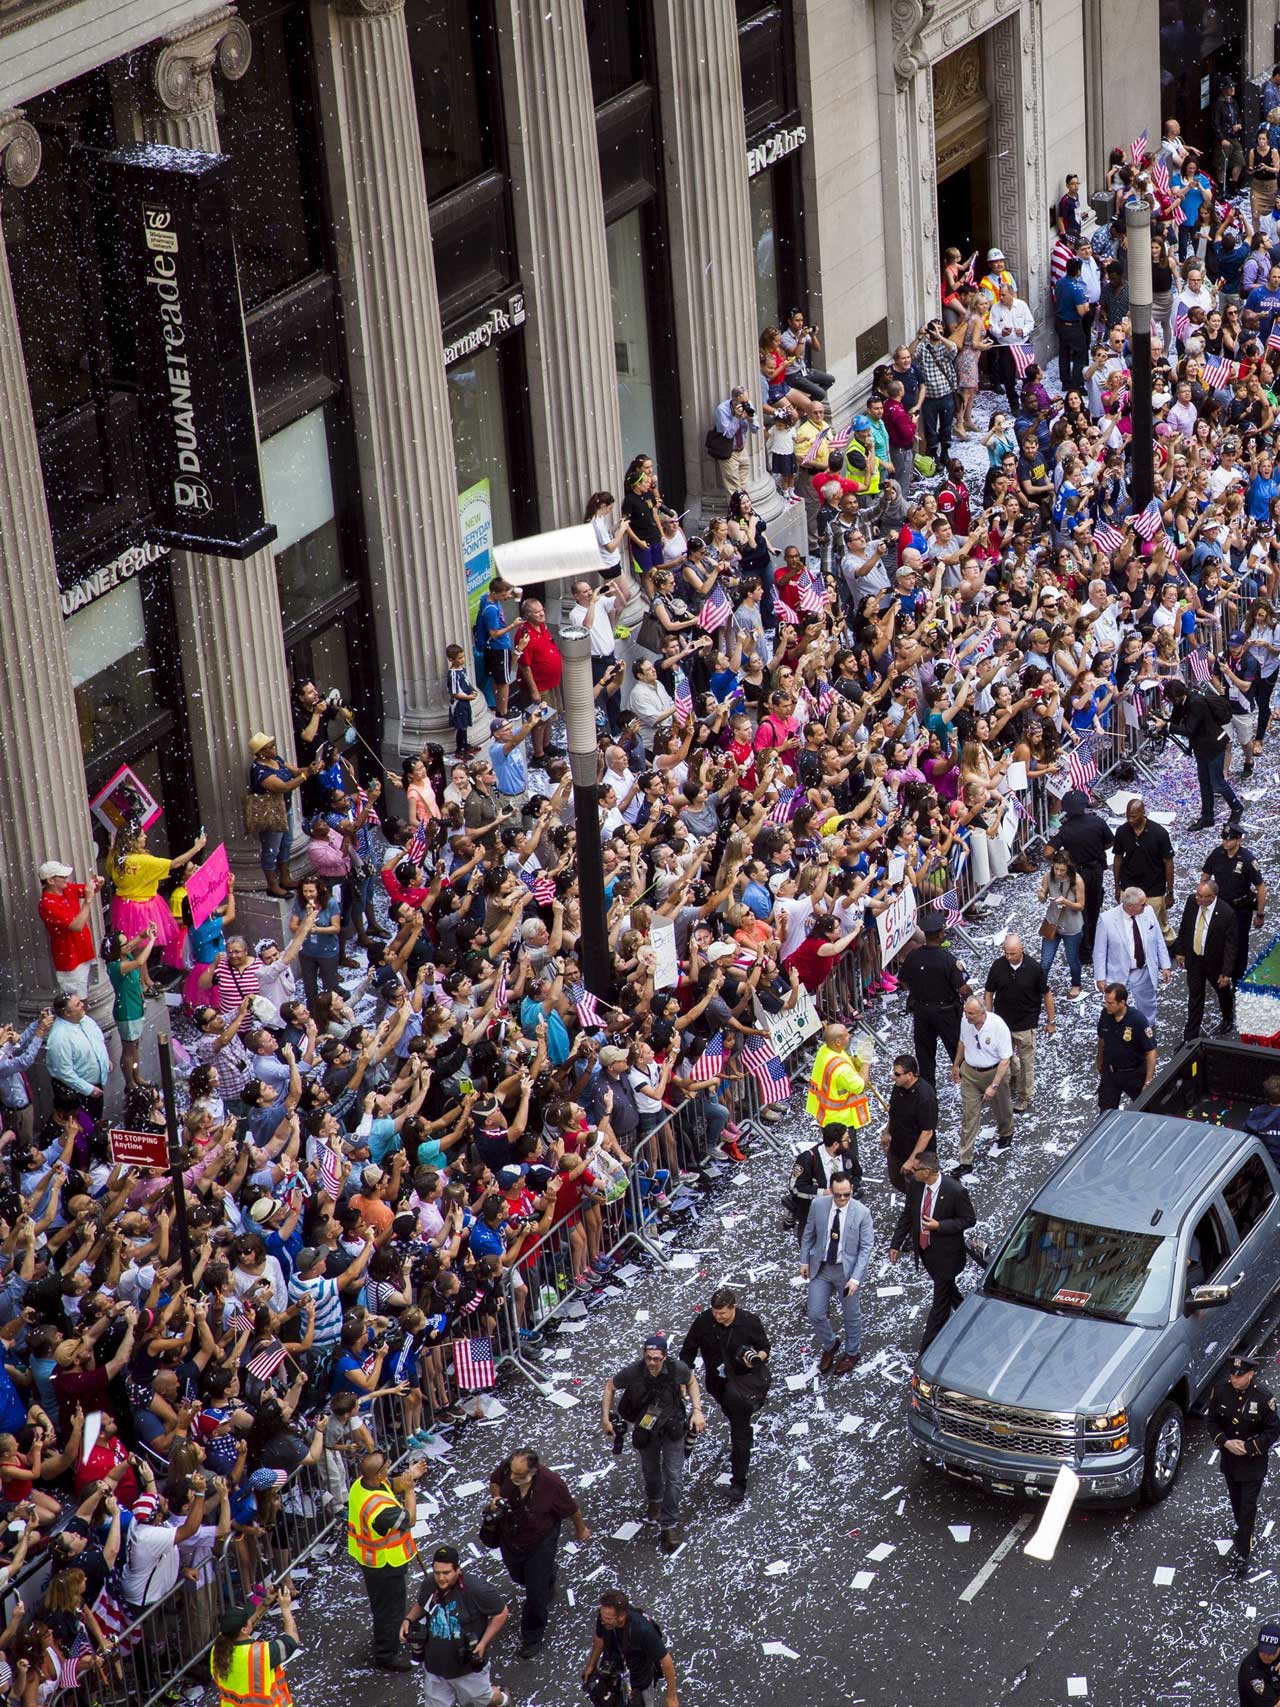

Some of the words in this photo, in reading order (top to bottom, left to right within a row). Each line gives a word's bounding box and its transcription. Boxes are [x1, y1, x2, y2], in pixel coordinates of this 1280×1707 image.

[746, 144, 767, 177] EN
[463, 520, 491, 547] ERYDAY
[466, 568, 492, 592] ewards
[778, 1031, 804, 1057] #3
[113, 1133, 123, 1141] NO
[124, 1135, 158, 1145] STOPPING
[114, 1141, 143, 1150] Anytime
[1056, 1295, 1080, 1303] FLOAT
[1260, 1634, 1279, 1645] NYPD
